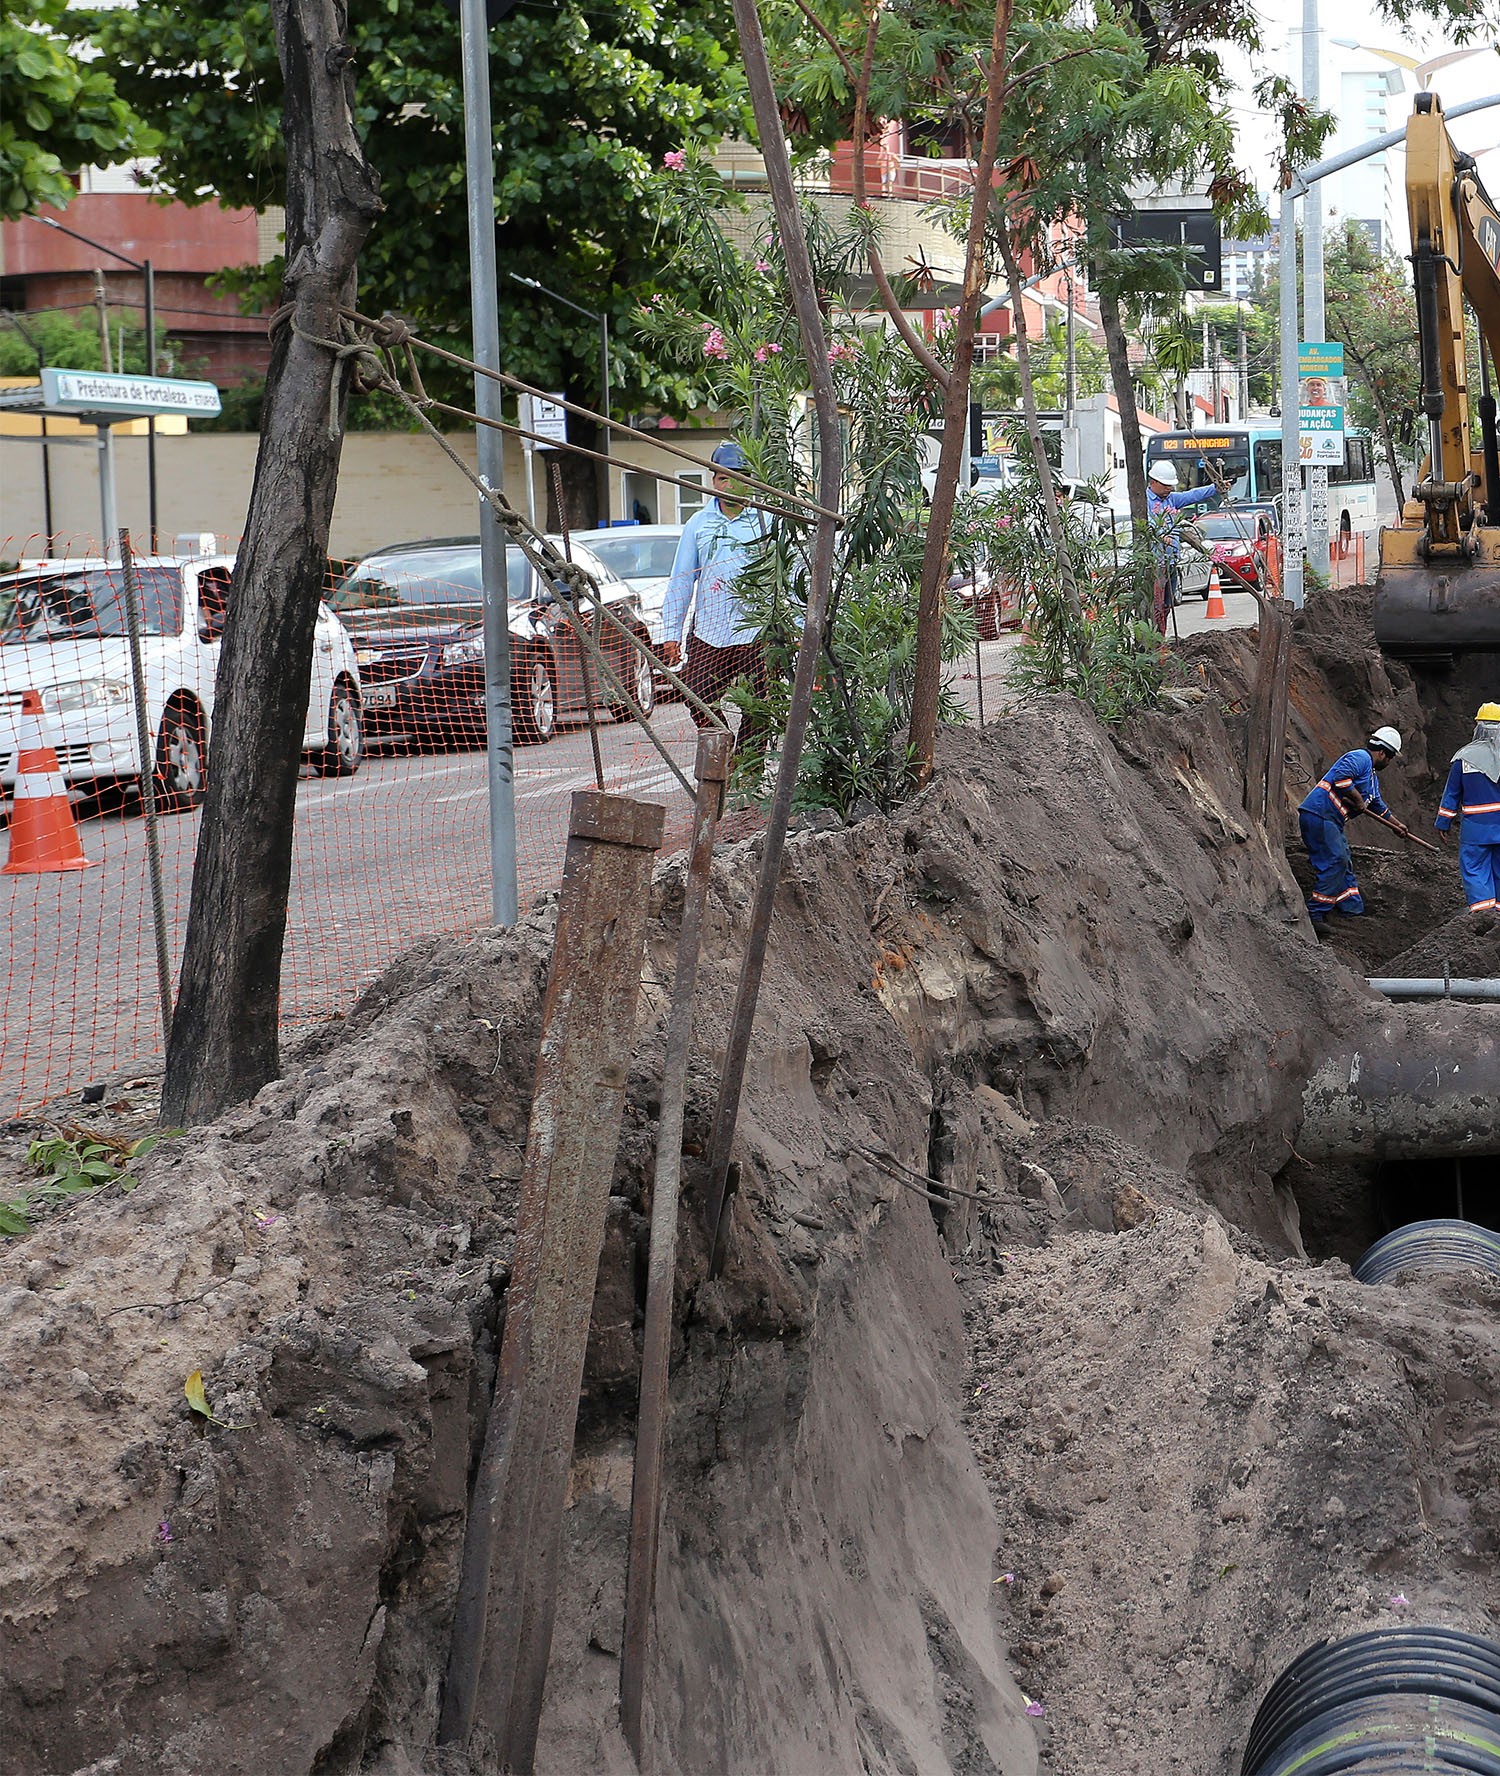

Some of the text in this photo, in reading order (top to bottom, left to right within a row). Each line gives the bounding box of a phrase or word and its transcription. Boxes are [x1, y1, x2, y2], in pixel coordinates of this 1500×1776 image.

[77, 380, 128, 399] Prefeitura
[130, 383, 142, 400] de
[144, 385, 187, 404] Fortaleza
[1310, 418, 1333, 430] AÇÃO.
[1163, 440, 1178, 450] 029
